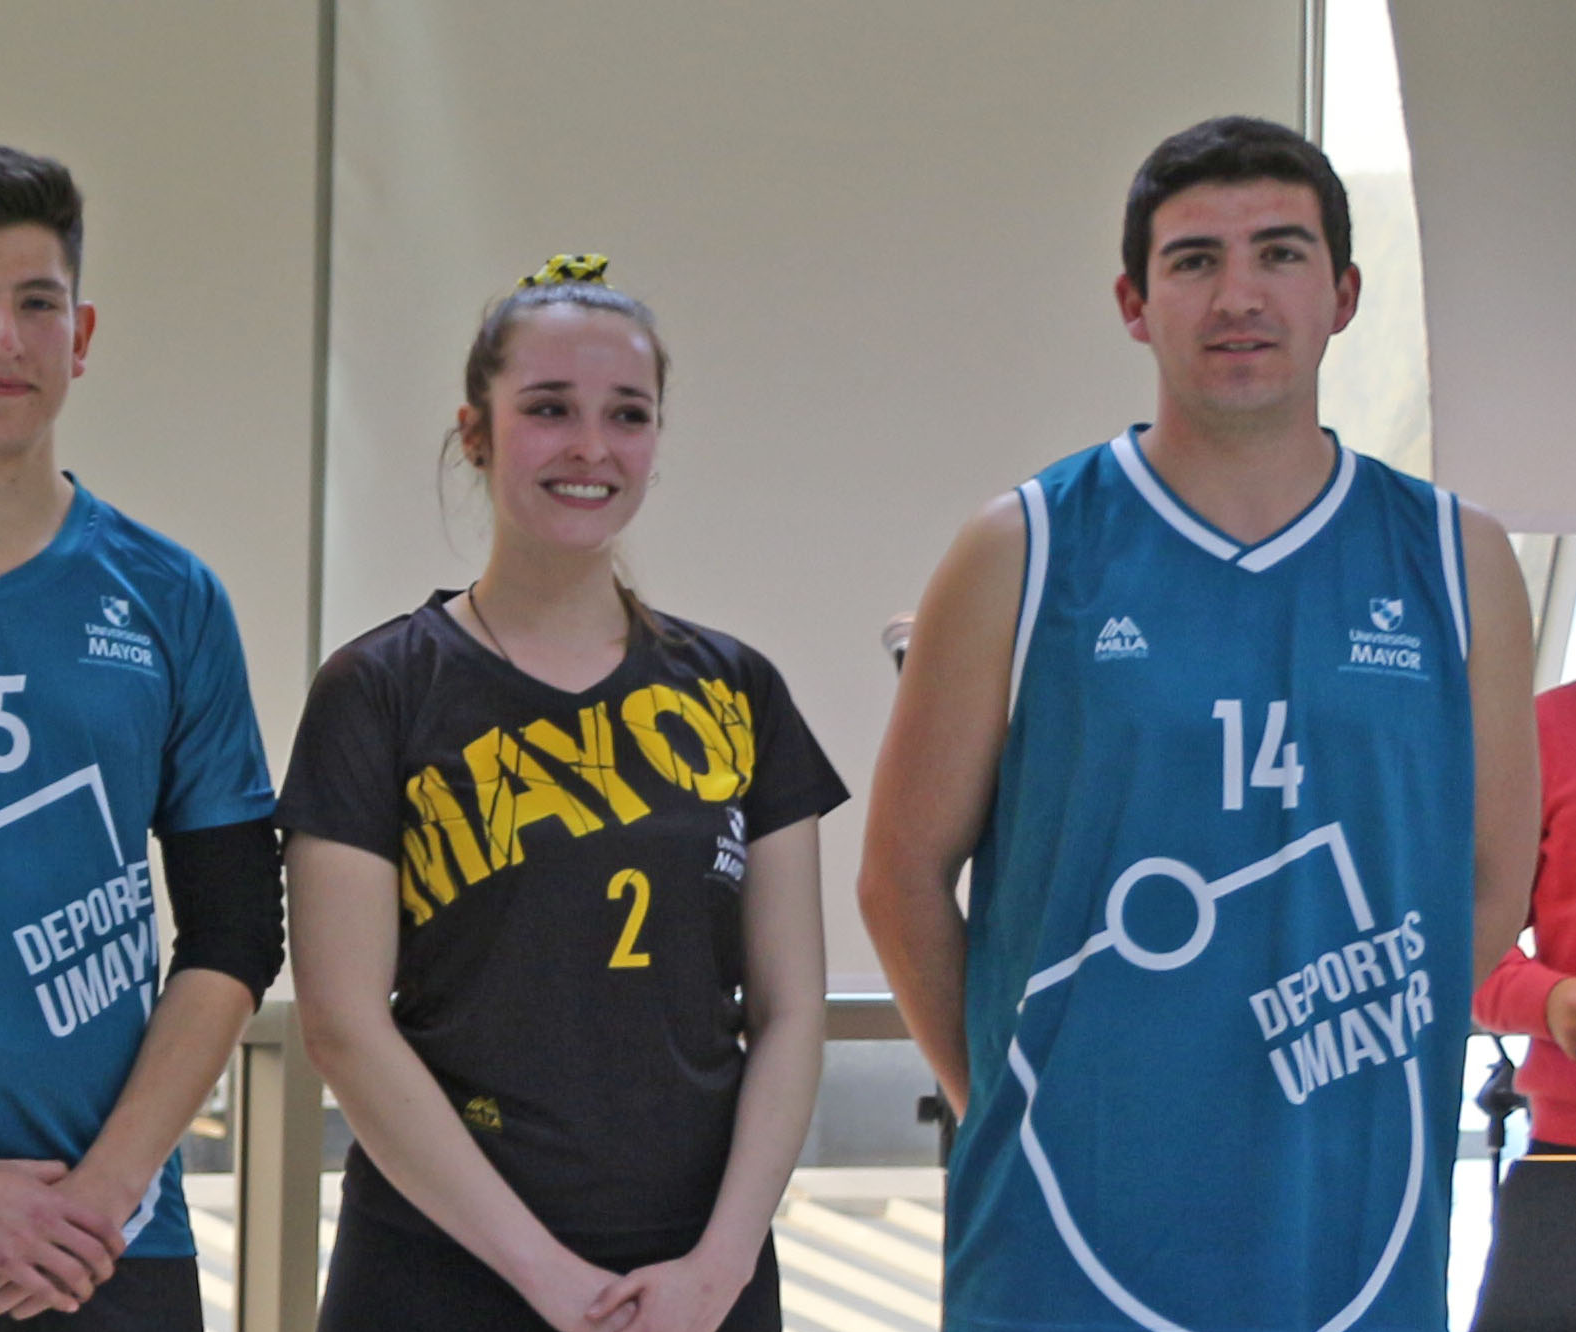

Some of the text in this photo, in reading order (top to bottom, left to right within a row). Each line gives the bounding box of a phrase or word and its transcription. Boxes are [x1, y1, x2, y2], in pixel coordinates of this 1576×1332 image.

[89, 637, 154, 667] MAYOR
[1350, 643, 1422, 671] MAYOR
[1211, 699, 1305, 811] 14
[606, 867, 652, 970] 2
